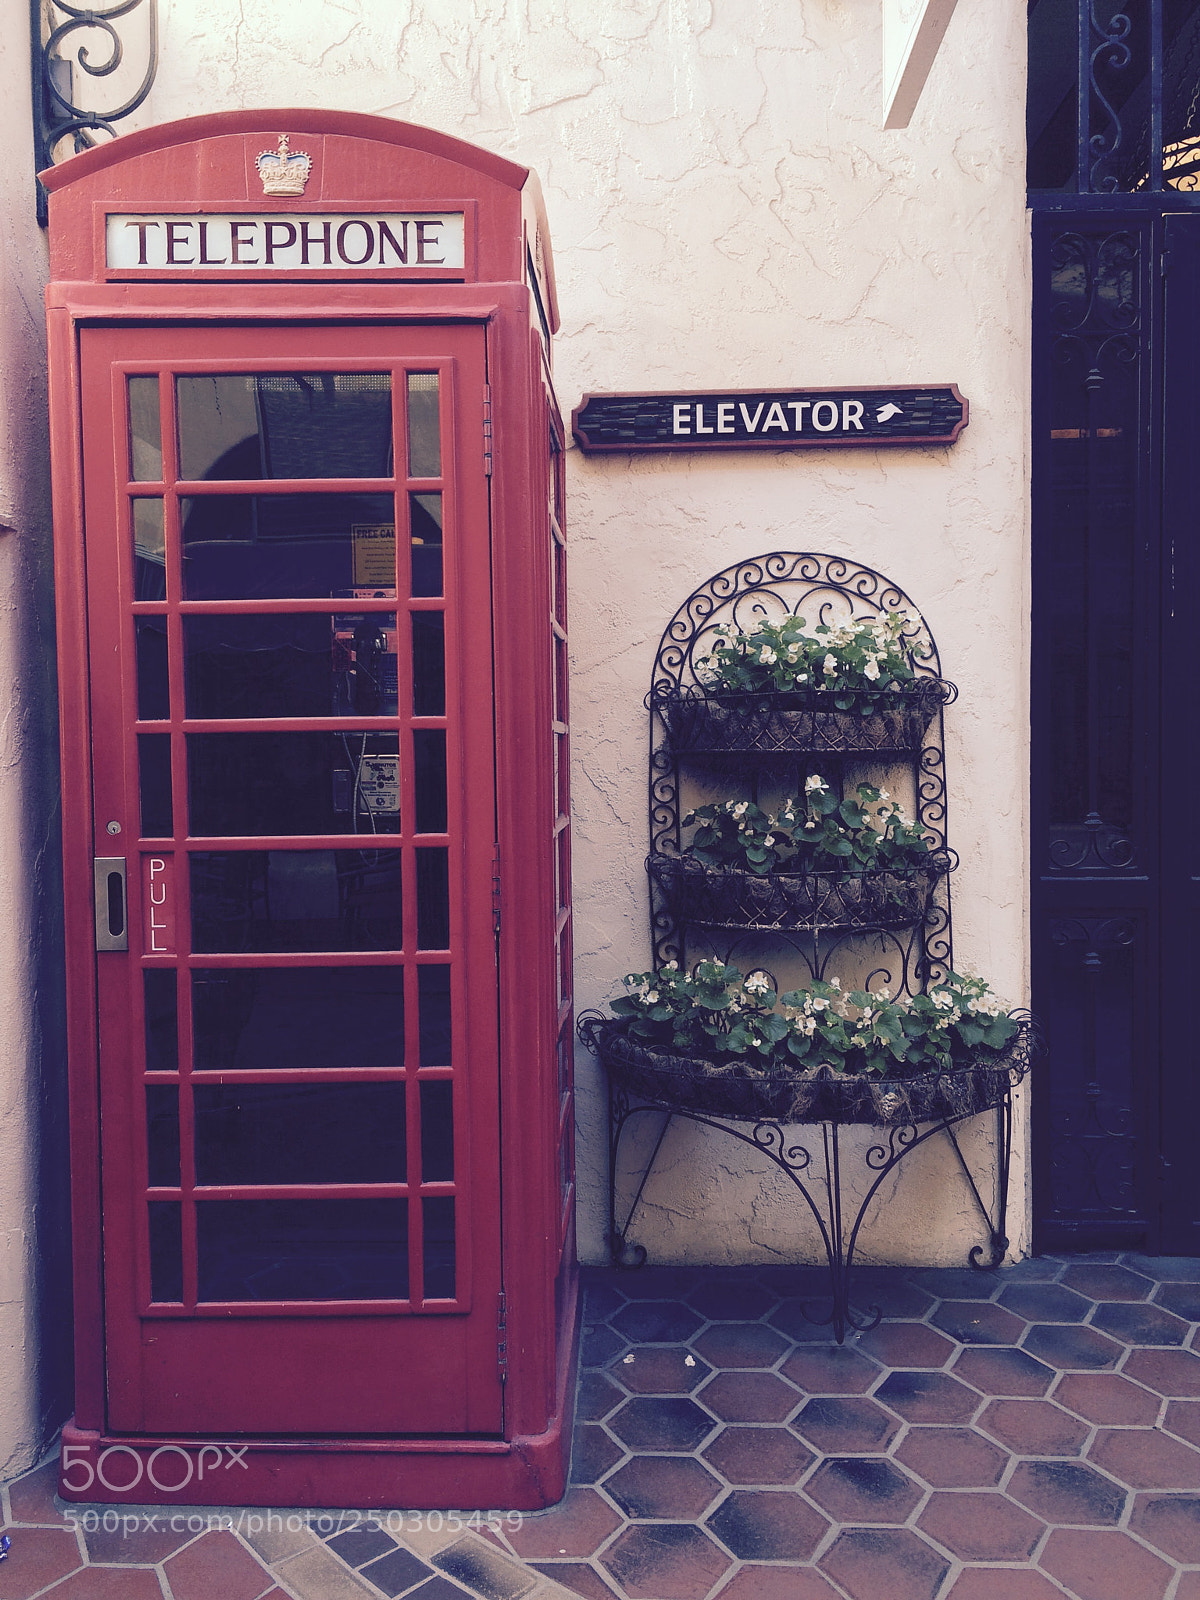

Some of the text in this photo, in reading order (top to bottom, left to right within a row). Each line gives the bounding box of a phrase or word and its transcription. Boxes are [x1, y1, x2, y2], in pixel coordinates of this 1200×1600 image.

[125, 219, 446, 265] TELEPHONE
[672, 400, 865, 435] ELEVATOR
[356, 529, 379, 539] FREE
[150, 858, 168, 951] PULL
